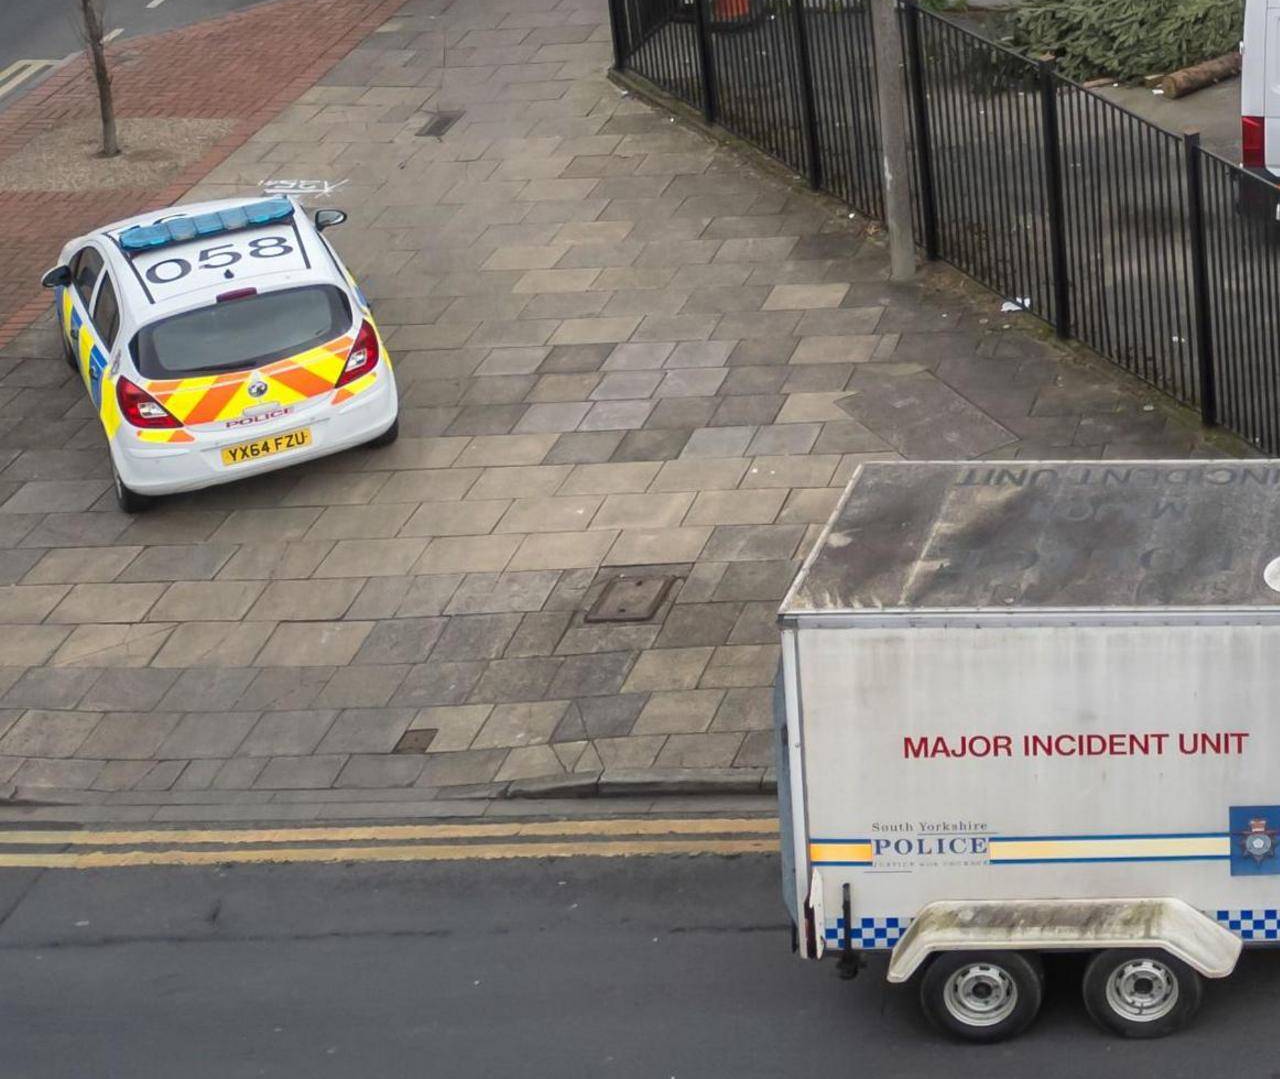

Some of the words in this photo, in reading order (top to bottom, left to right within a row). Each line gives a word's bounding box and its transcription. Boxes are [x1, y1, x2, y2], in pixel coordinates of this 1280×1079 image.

[145, 236, 294, 284] 058
[229, 441, 270, 461] YX64
[275, 432, 305, 450] FZU
[904, 735, 1012, 759] MAJOR
[1023, 733, 1169, 757] INCIDENT
[1178, 732, 1249, 754] UNIT
[871, 822, 913, 832] South
[919, 821, 988, 832] Yorkshire
[875, 837, 988, 855] POLICE
